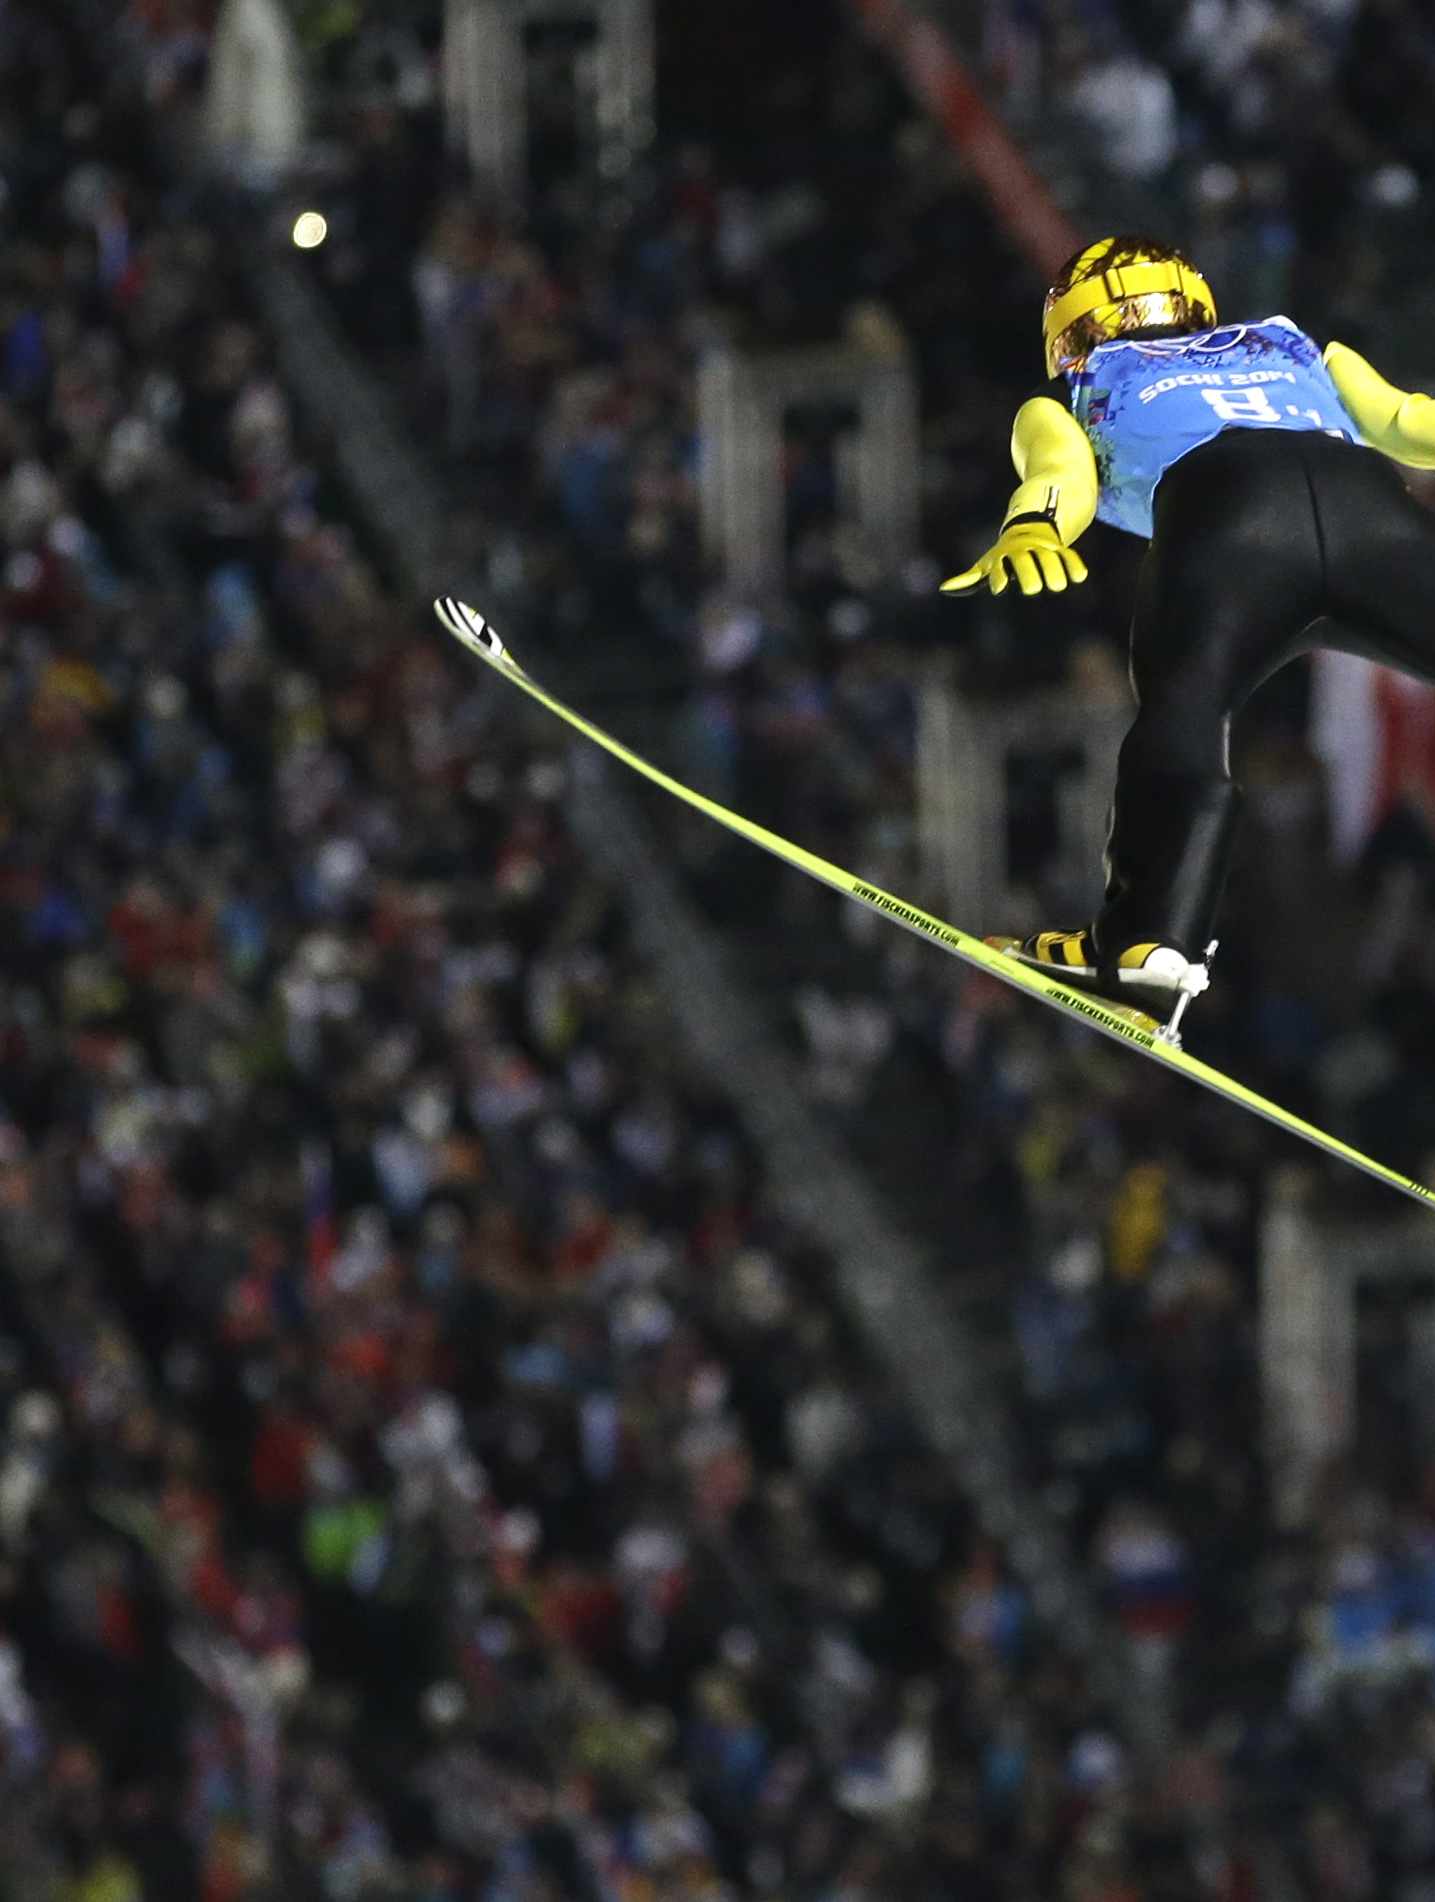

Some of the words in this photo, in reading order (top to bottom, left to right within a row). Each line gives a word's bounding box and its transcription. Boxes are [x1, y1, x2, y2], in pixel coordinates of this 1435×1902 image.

[1138, 373, 1224, 404] SOCHI
[1228, 370, 1297, 386] 2014
[852, 881, 960, 948] WWW.FISCHERSPORTS.COM
